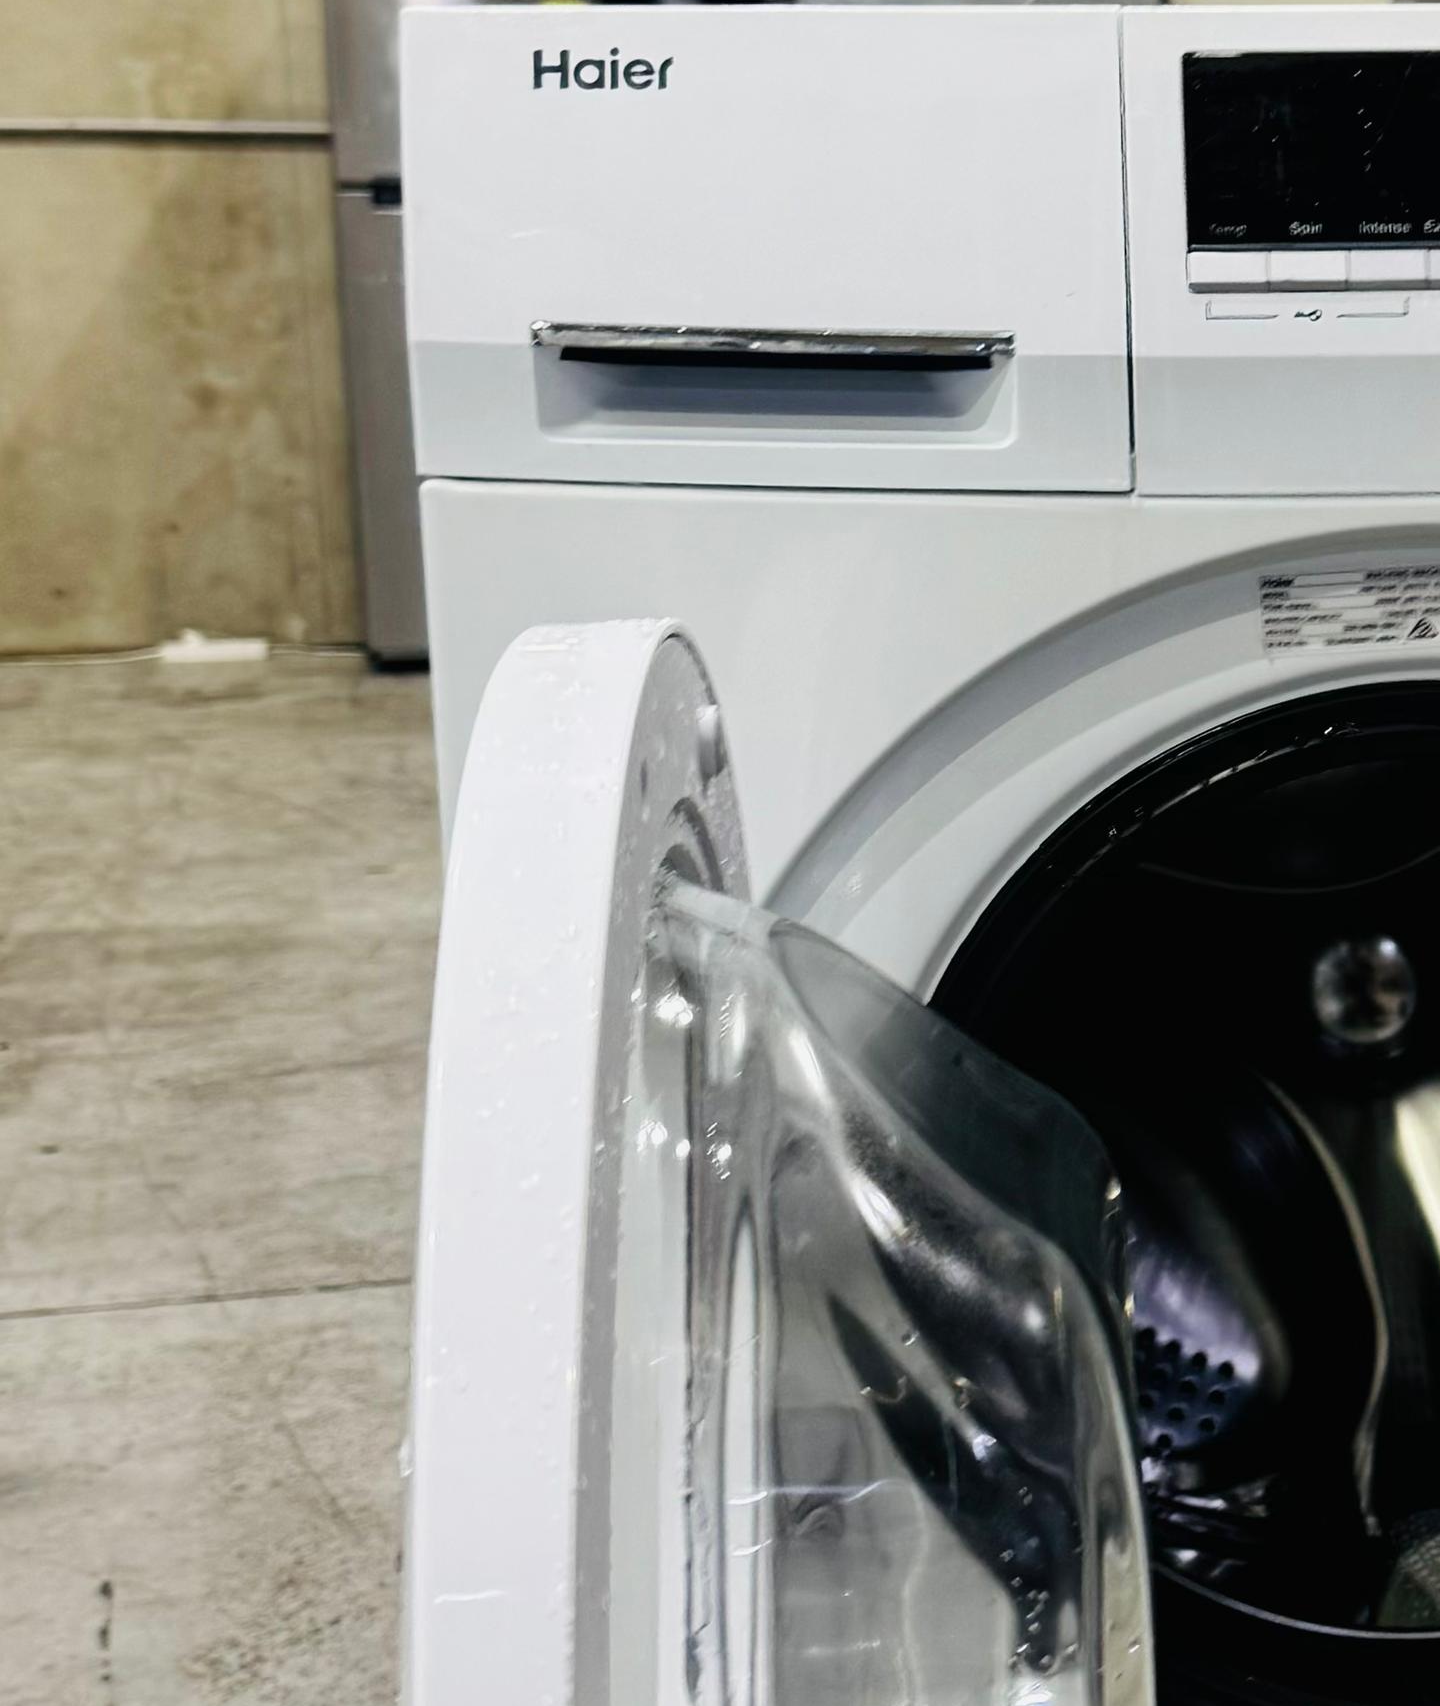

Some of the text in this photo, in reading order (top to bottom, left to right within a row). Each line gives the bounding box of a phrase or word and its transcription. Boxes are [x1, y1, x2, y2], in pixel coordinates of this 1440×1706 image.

[532, 47, 674, 90] Haier
[1288, 221, 1323, 236] Spin
[1358, 220, 1412, 234] Intense
